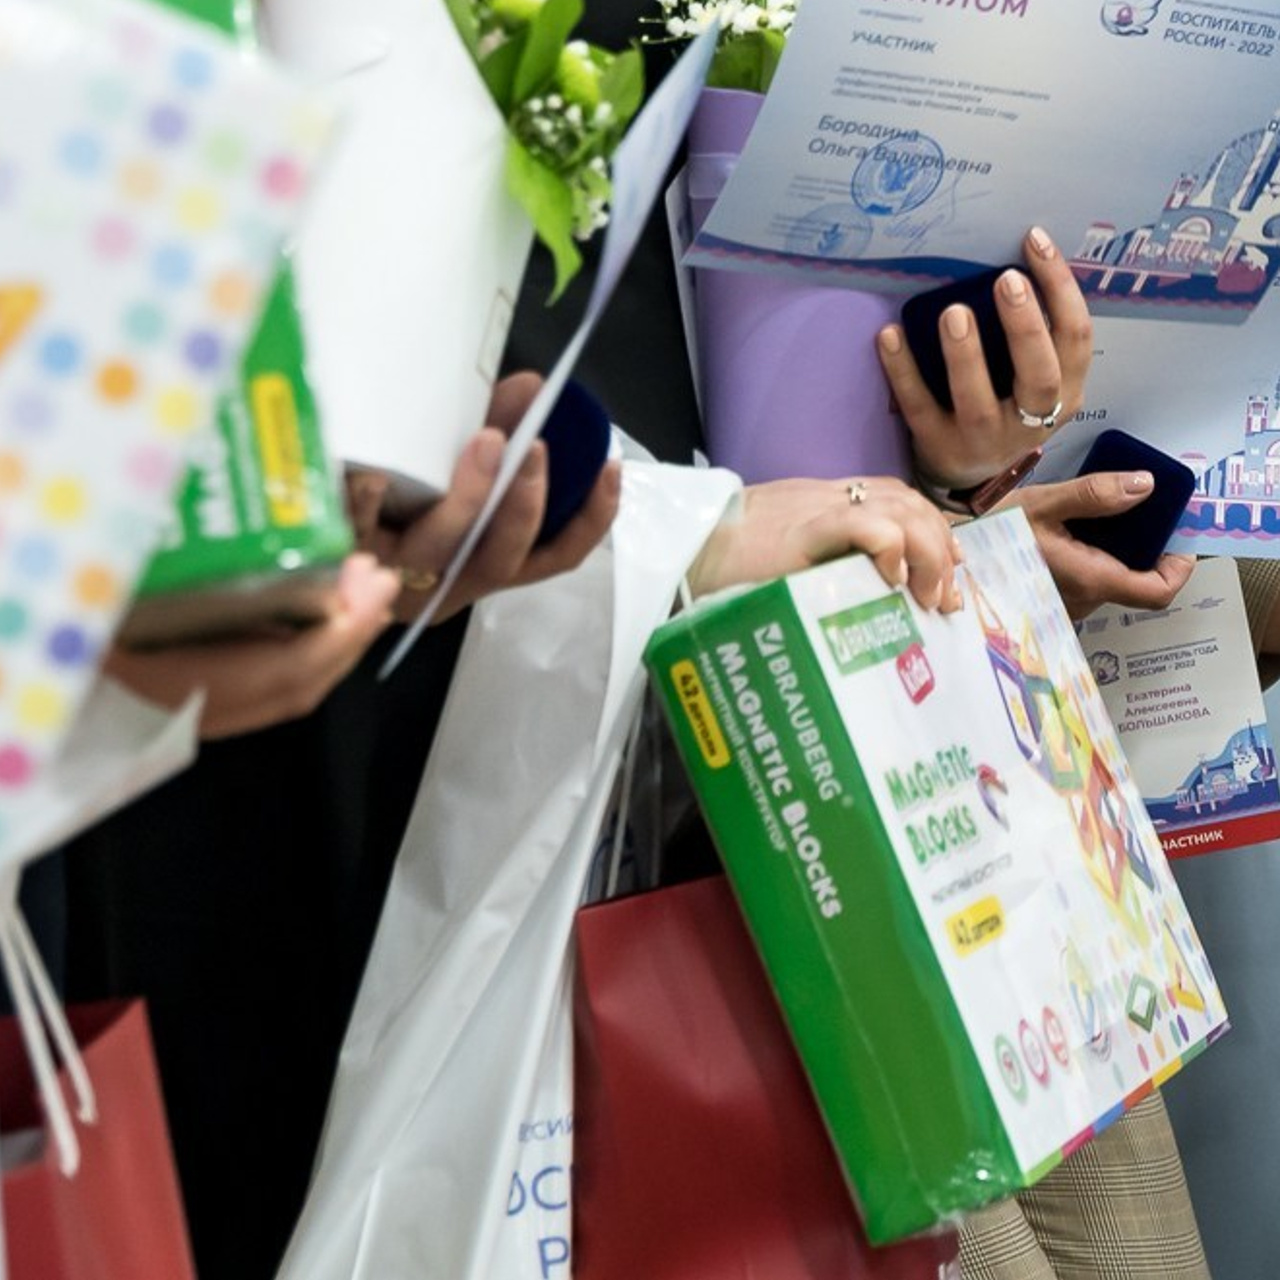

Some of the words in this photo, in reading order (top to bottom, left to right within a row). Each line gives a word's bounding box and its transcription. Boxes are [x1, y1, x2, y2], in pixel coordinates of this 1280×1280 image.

[1169, 10, 1276, 40] ВОСПИТАТЕЛЬ
[851, 31, 938, 53] УЧАСТНИК
[1164, 28, 1225, 48] РОССИИ
[1237, 40, 1274, 57] 2022
[817, 115, 919, 142] Бородина
[808, 138, 867, 160] Ольга
[1127, 651, 1192, 669] ВОСПИТАТЕЛЬ
[1193, 644, 1219, 656] ГОДА
[1174, 659, 1196, 671] 2022
[680, 672, 699, 698] 42
[1126, 683, 1192, 703] Екатерина
[1118, 707, 1211, 733] БОЛЬШАКОВА
[1125, 697, 1199, 718] Алексеевна
[767, 655, 843, 803] BRAUBERG
[716, 641, 793, 798] MAGNETIC
[781, 800, 843, 919] BLOCKS
[1161, 829, 1224, 852] ЧАСТНИК
